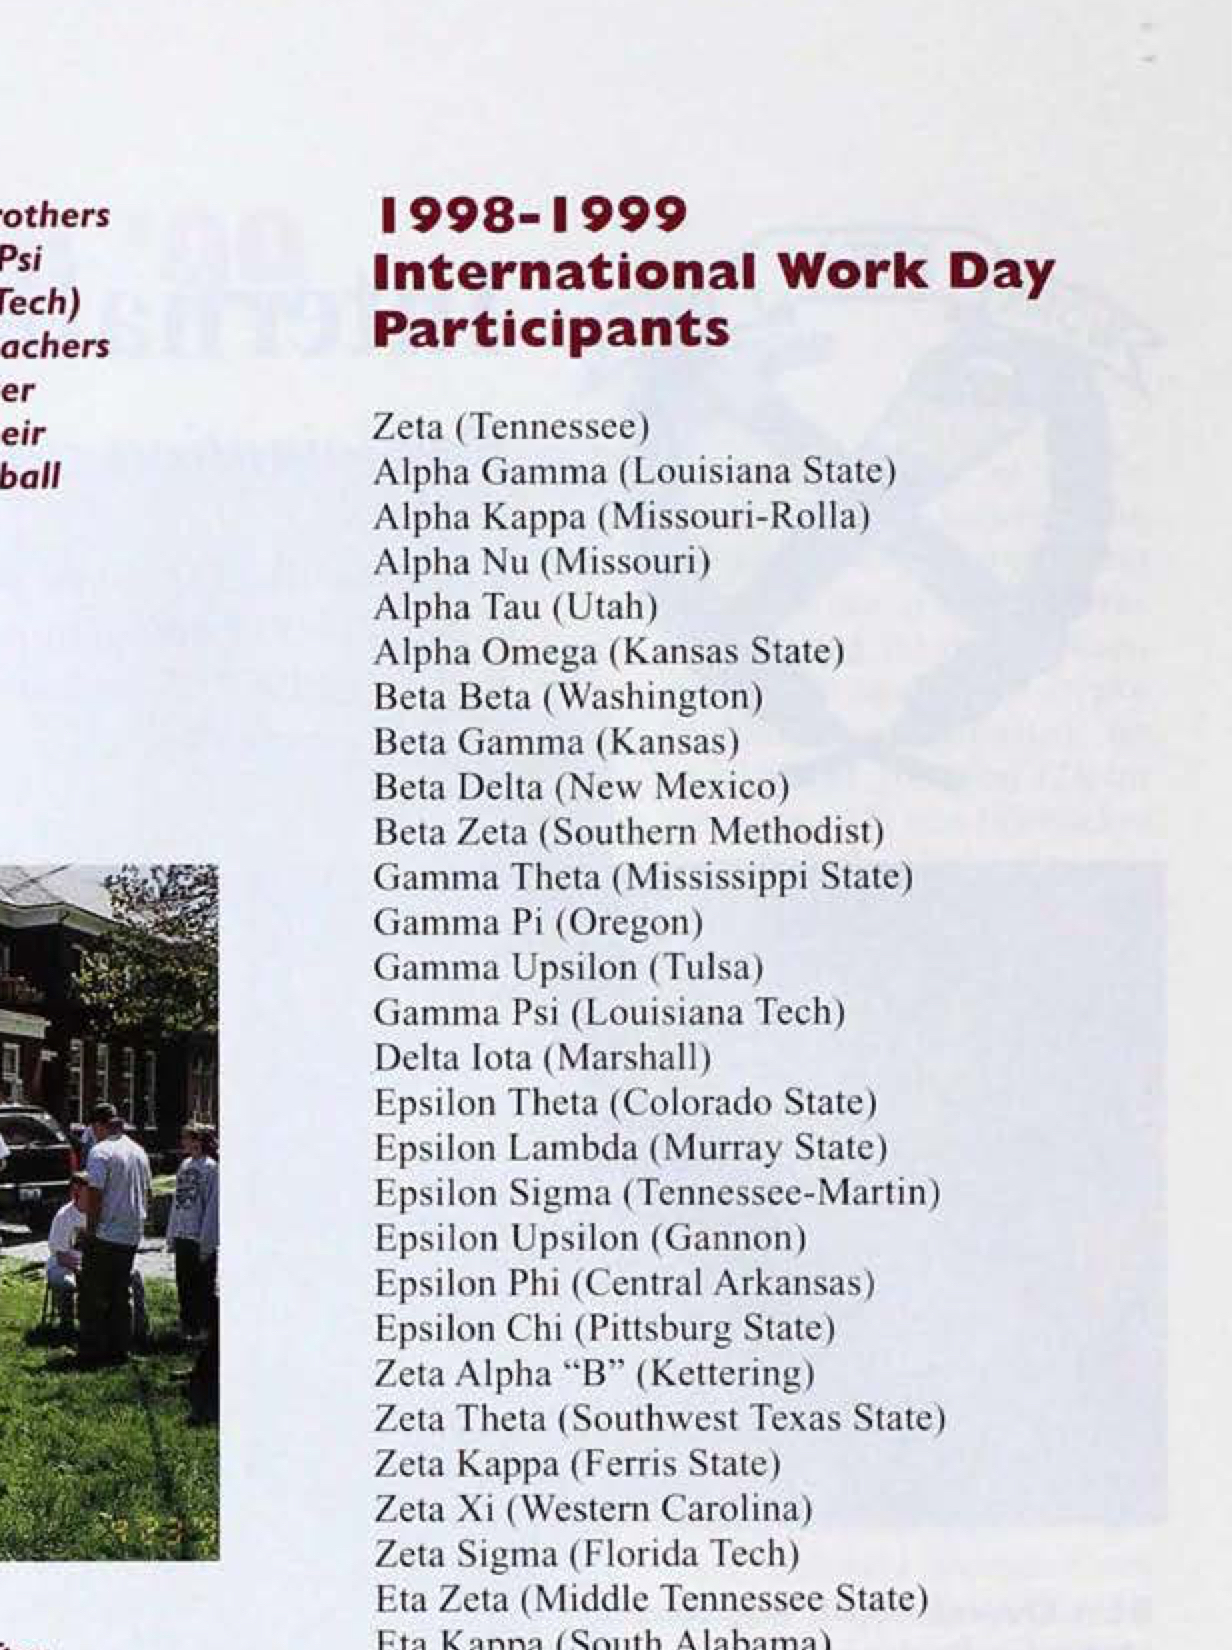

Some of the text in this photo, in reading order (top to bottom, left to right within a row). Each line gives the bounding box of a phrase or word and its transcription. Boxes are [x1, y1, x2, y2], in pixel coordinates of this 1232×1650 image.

[381, 194, 687, 234] 1998-1999
[373, 250, 1057, 300] International Work Day
[373, 308, 730, 359] Participants
[373, 412, 649, 443] Zeta (Tennessee)
[373, 454, 897, 494] Alpha Gamma (Louisiana State)
[373, 590, 657, 628] Alpha Tau (Utah)
[375, 680, 763, 718] Beta Beta (Washington)
[373, 860, 913, 898] Gamma Theta (Mississippi State)
[376, 1176, 940, 1215] Epsilon Sigma (Tennessee-Martin)
[375, 1448, 781, 1486] Zeta Kappa (Ferris State)
